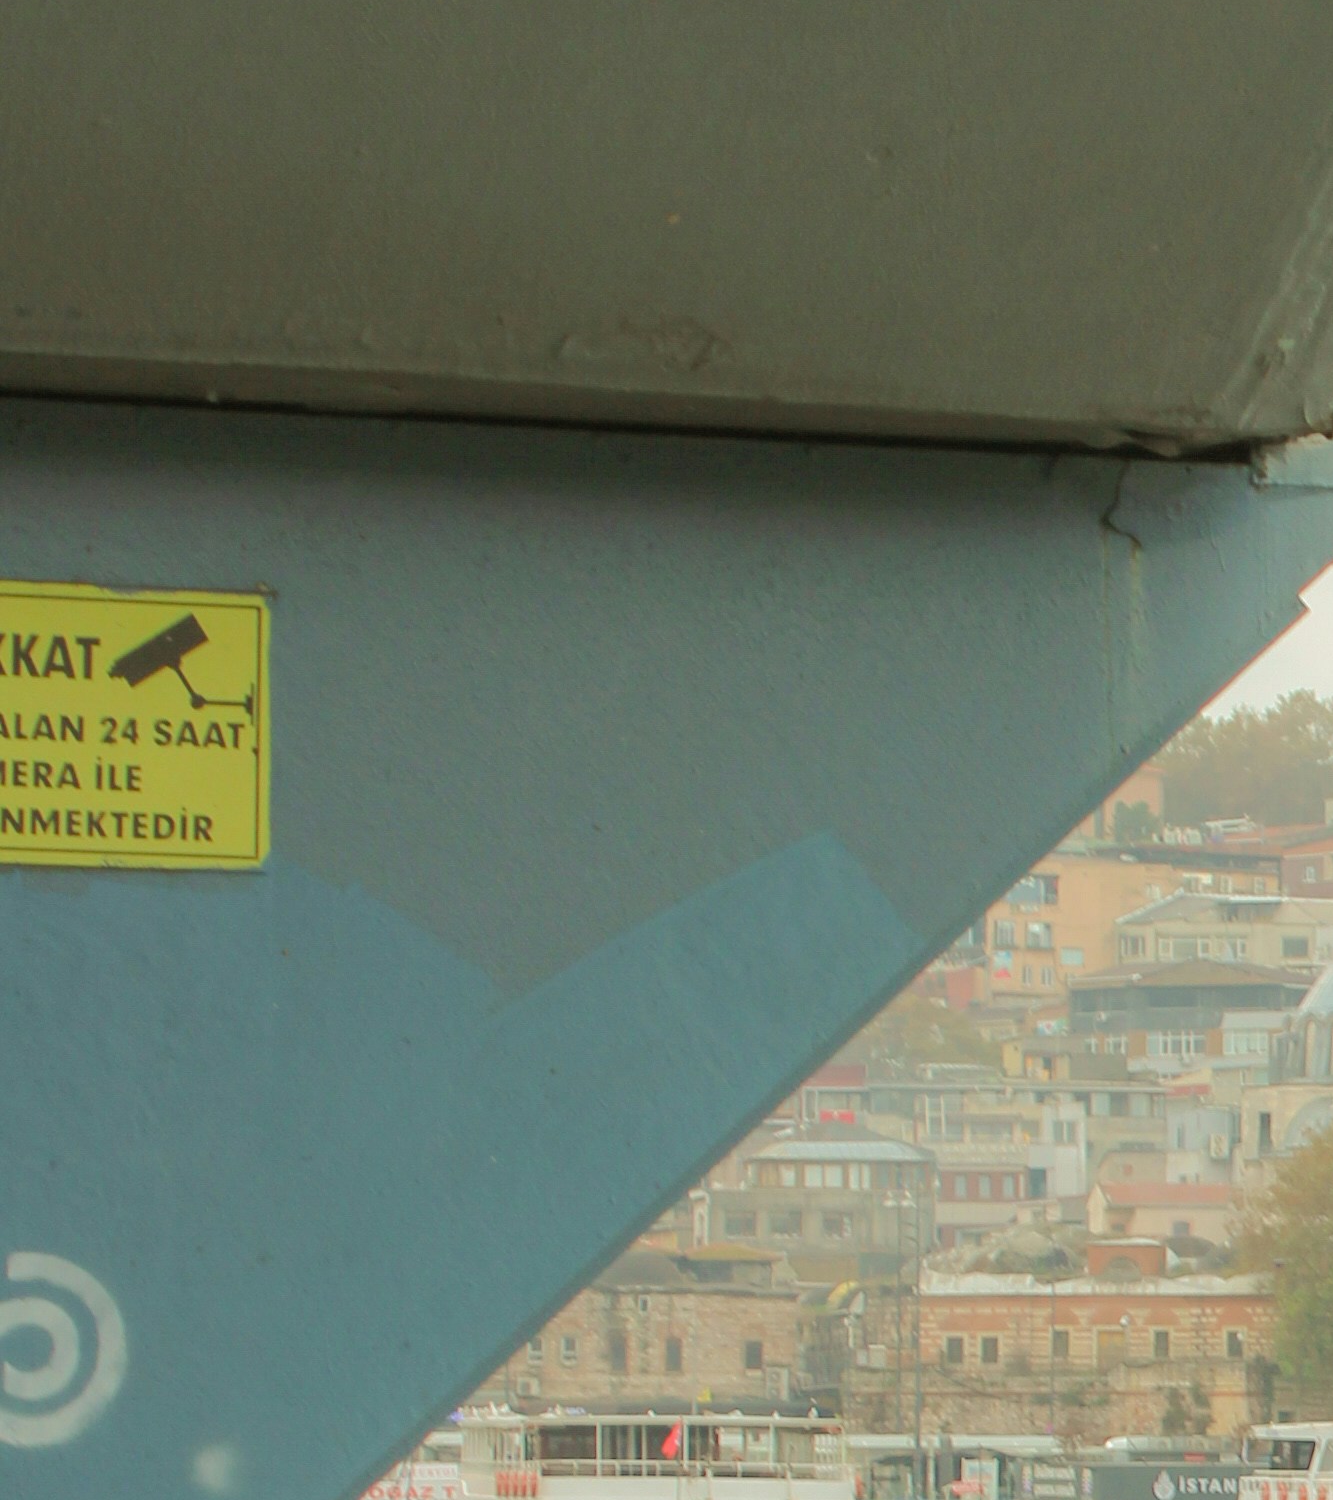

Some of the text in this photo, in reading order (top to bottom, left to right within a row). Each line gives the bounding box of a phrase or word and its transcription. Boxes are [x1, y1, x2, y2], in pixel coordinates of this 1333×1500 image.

[0, 632, 100, 681] KAT
[101, 716, 139, 745] 24
[154, 719, 245, 749] SAAT
[0, 756, 142, 793] ERA İLE
[1, 807, 213, 843] NMEKTEDİR
